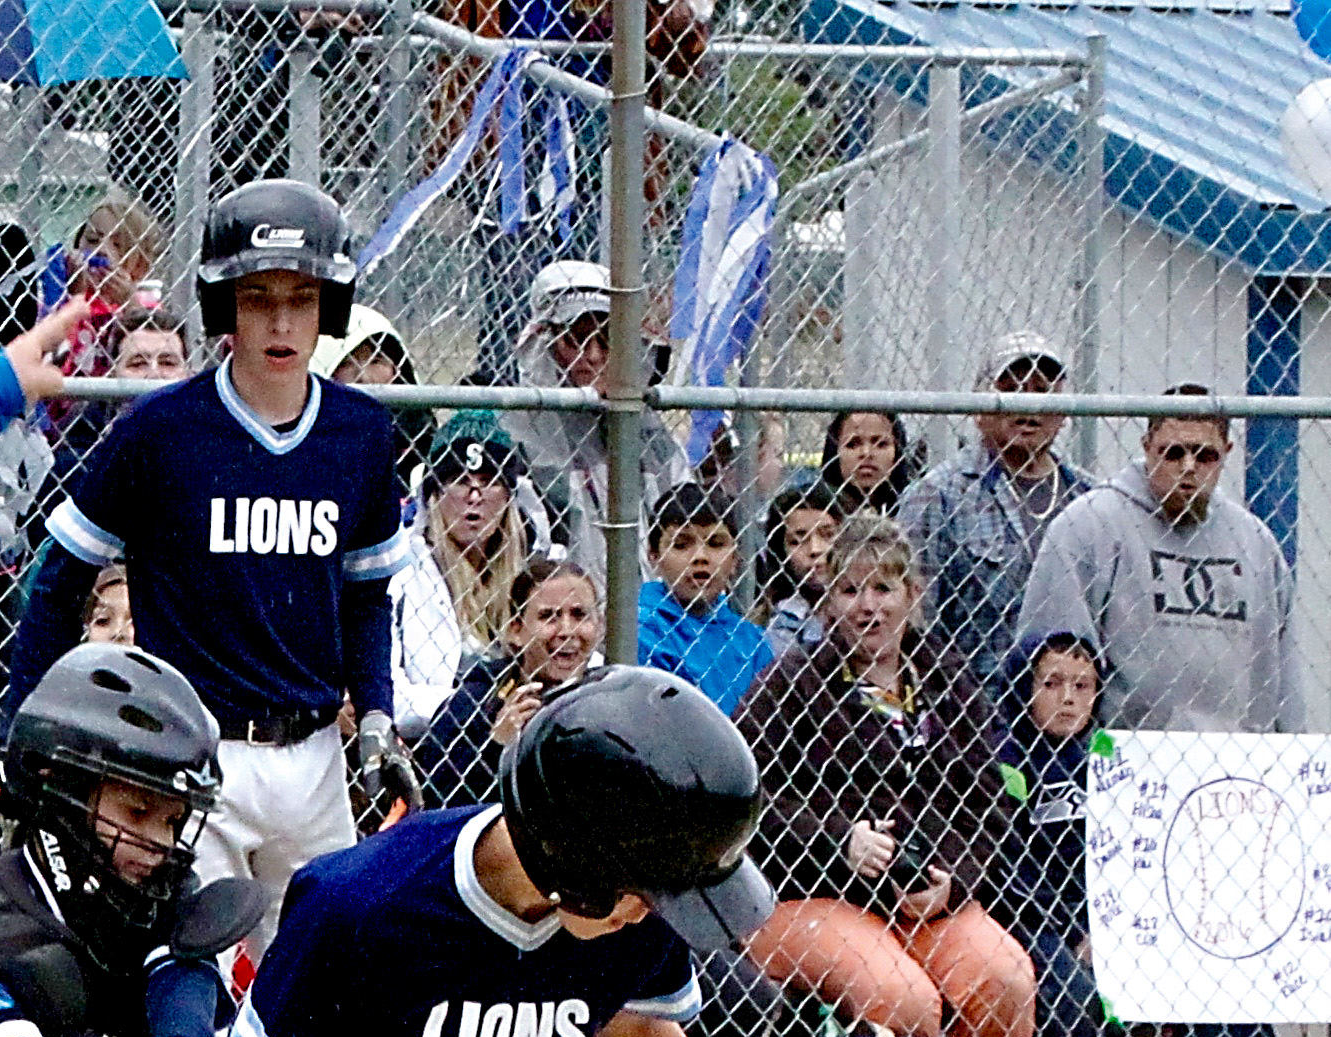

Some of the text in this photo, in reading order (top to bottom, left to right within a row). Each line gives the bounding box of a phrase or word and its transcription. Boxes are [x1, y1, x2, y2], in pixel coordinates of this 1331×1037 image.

[466, 443, 483, 470] S
[209, 496, 339, 557] LIONS
[1197, 786, 1268, 821] LIONS
